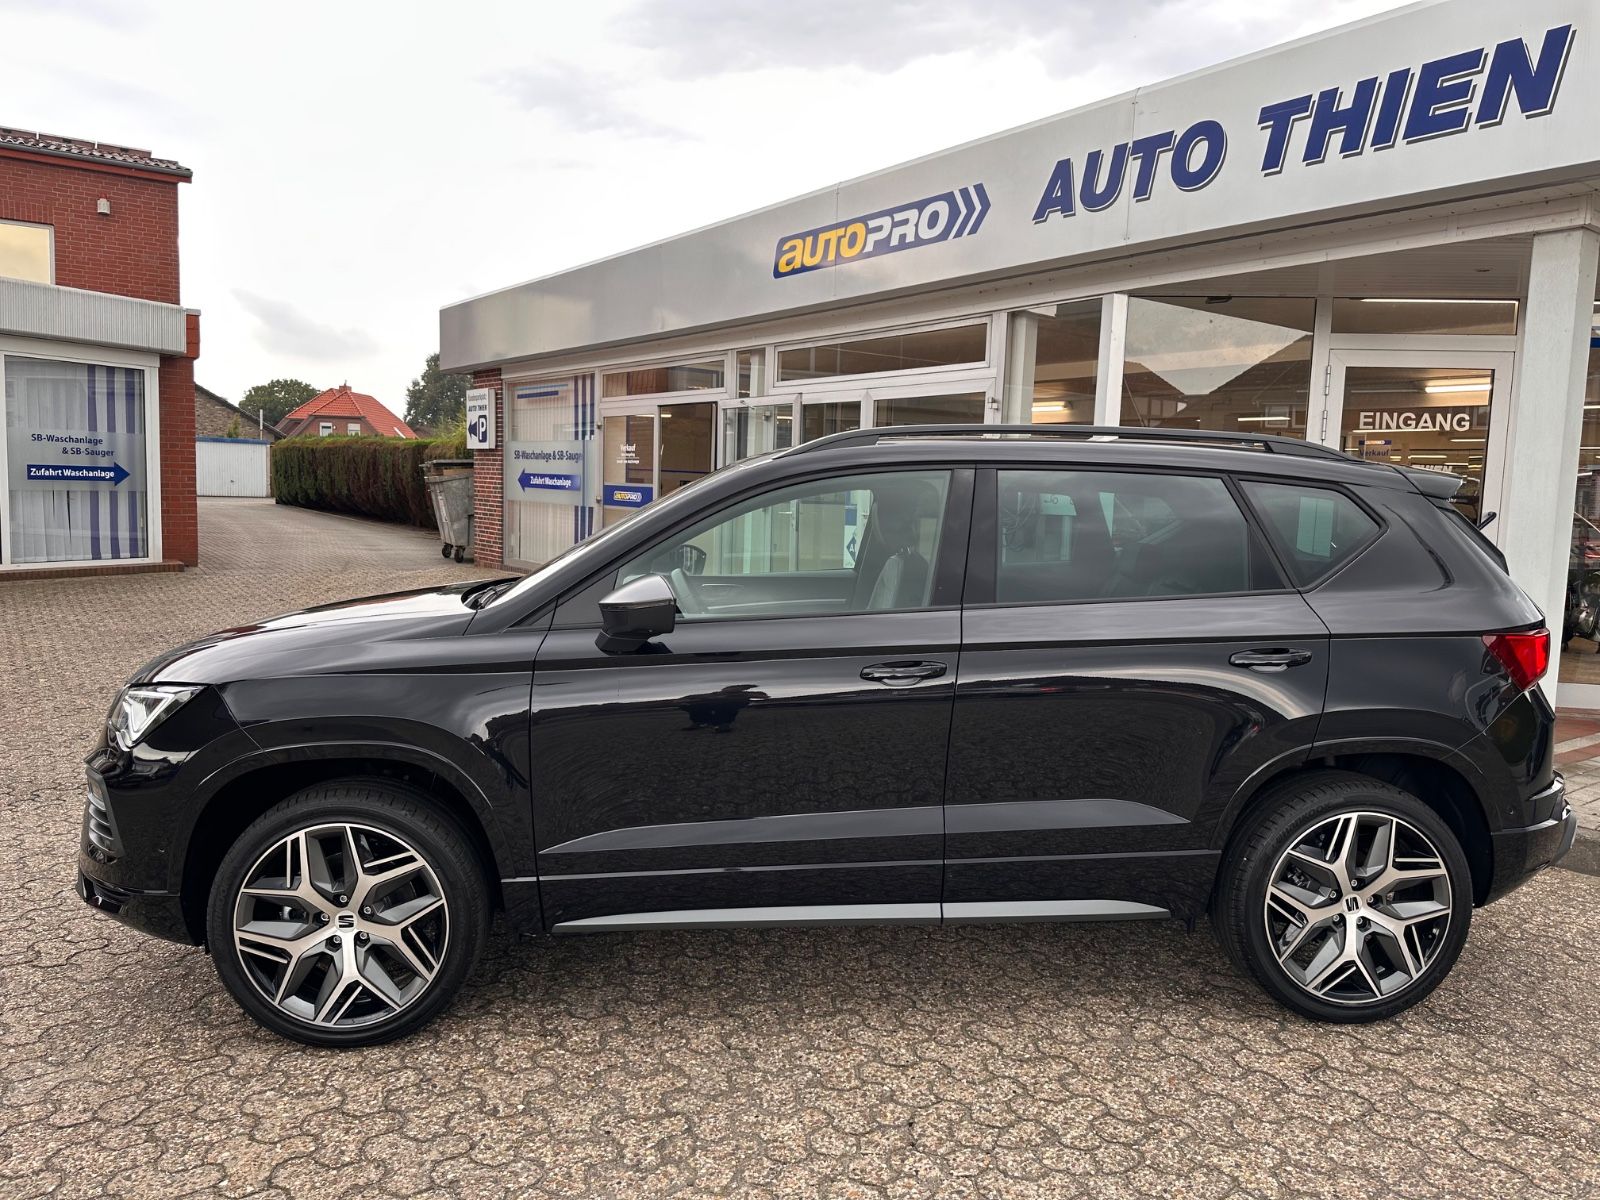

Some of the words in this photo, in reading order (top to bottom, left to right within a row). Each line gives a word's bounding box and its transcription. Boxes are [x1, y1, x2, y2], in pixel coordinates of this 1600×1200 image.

[1032, 119, 1228, 225] AUTO
[1257, 23, 1578, 178] THIEN
[1359, 411, 1471, 432] EINGANG
[31, 433, 103, 446] SB-Waschanlage
[61, 446, 69, 455] &
[70, 447, 115, 458] SB-Sauger
[513, 449, 552, 463] SB-Waschanlage
[30, 467, 62, 477] Zufahrt
[62, 468, 115, 479] Waschanlage
